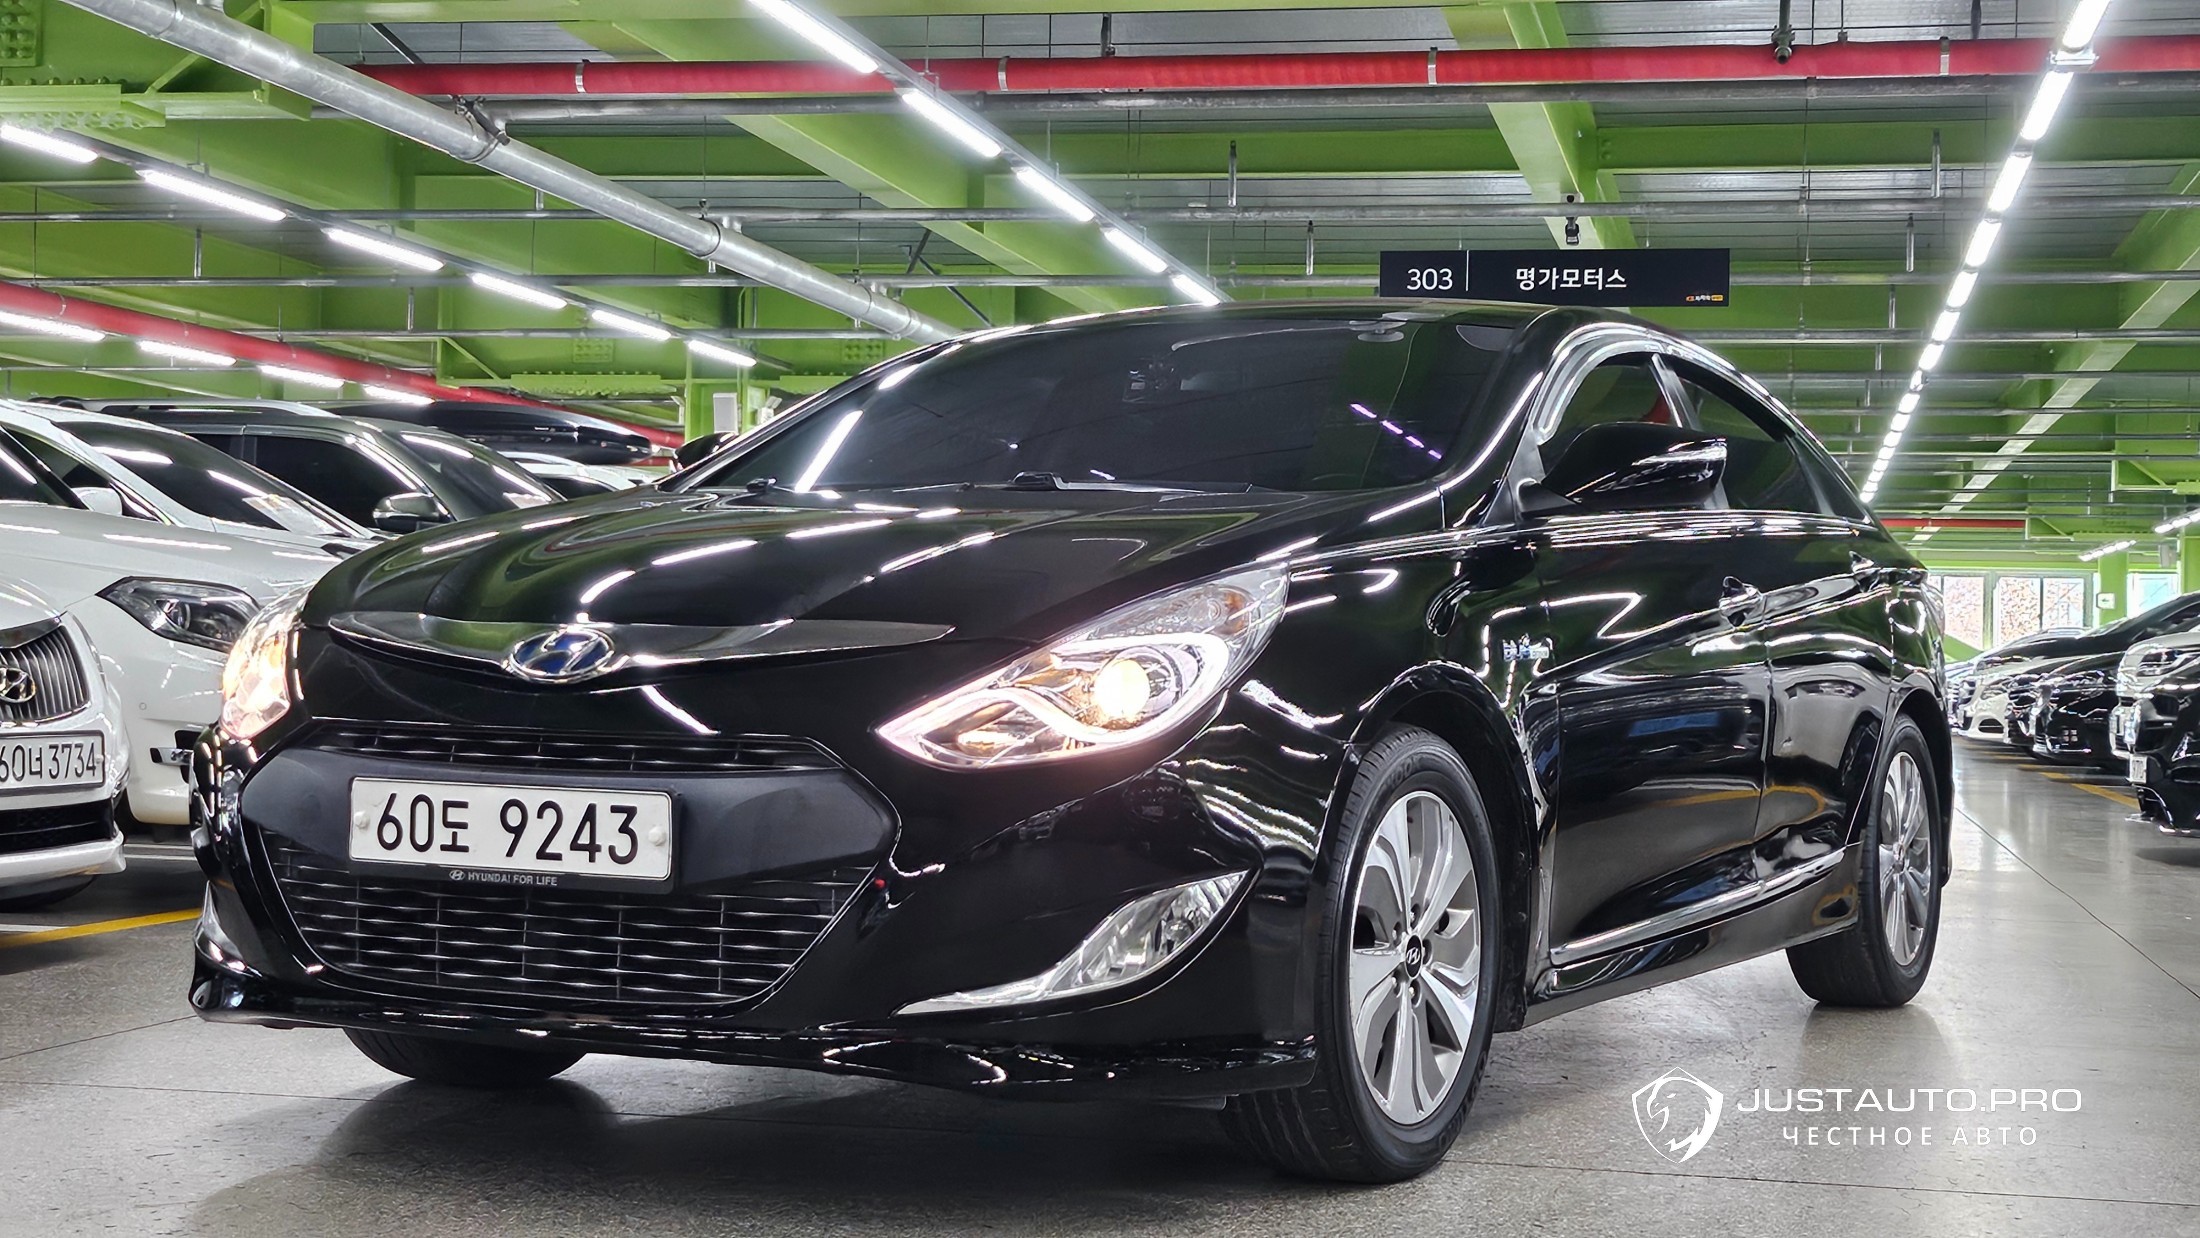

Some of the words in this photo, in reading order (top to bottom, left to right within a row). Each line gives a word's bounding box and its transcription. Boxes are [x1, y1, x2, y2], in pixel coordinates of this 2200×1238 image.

[1406, 268, 1454, 291] 303
[1515, 267, 1627, 291] 명가모터스
[0, 745, 42, 783] 60너
[48, 742, 97, 779] 3734
[376, 792, 470, 853] 60도
[499, 798, 639, 865] 9243
[467, 872, 511, 883] HYUNDAI
[513, 875, 533, 885] FOR
[536, 876, 558, 886] LIFE
